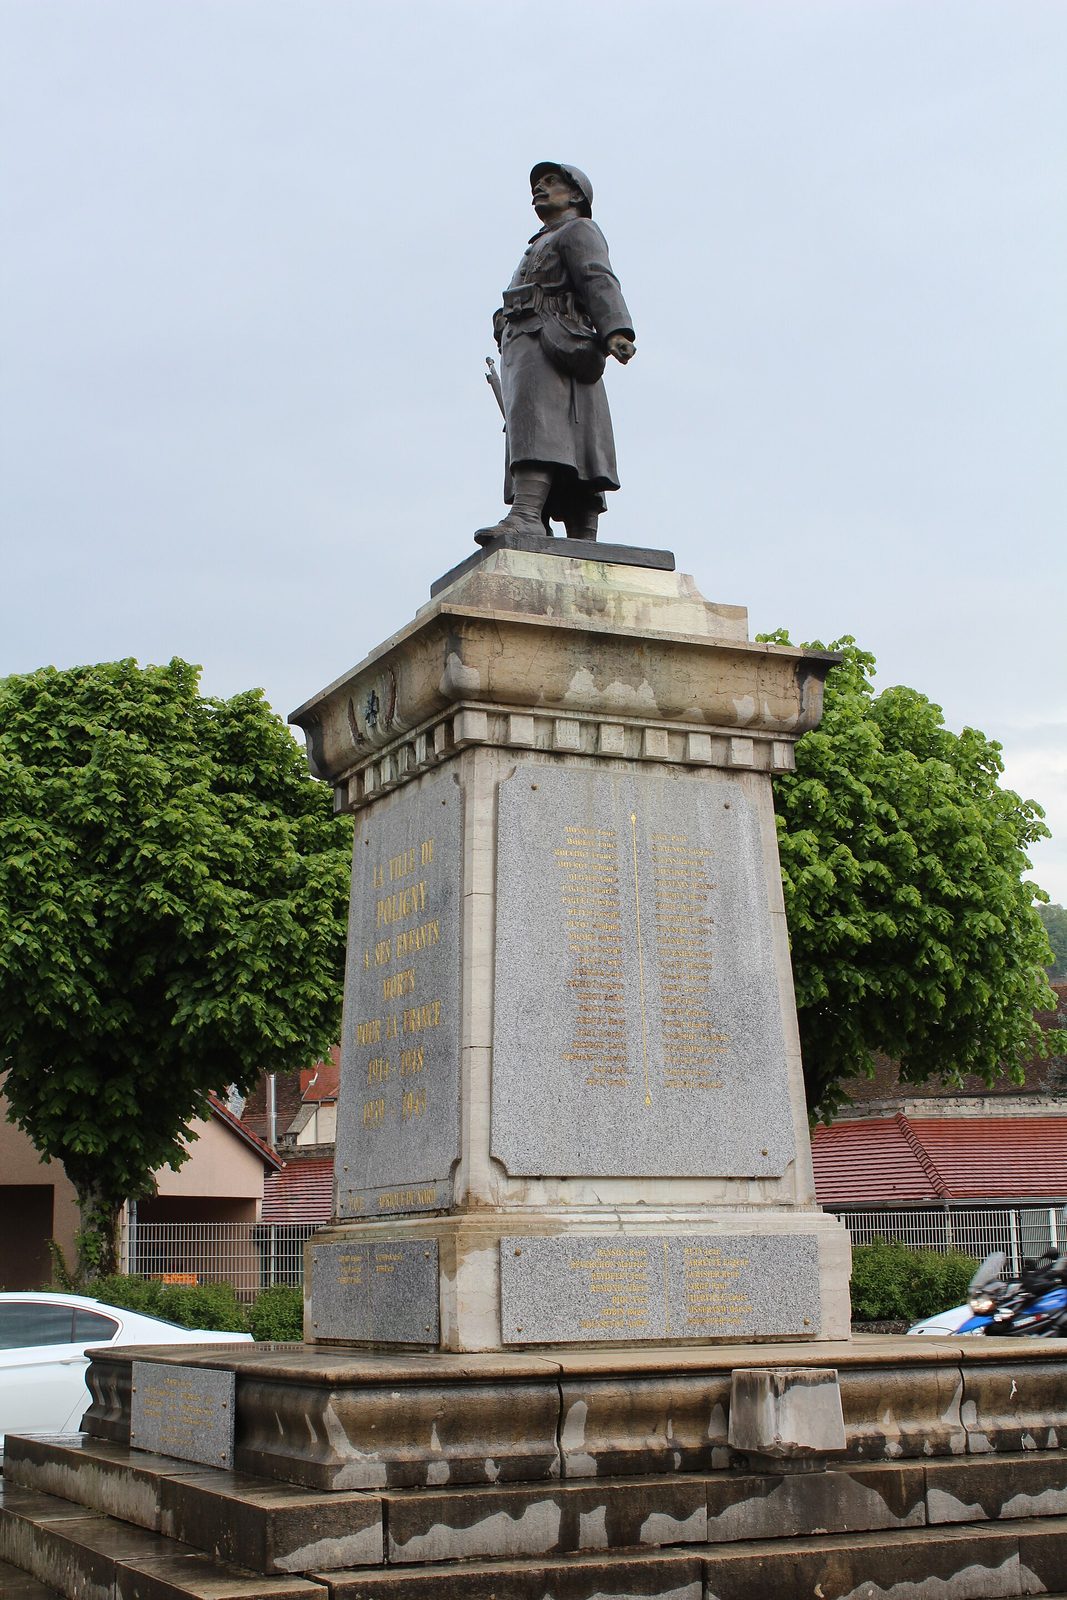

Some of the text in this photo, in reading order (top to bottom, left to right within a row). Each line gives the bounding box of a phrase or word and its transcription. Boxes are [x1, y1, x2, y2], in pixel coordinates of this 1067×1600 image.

[373, 838, 433, 888] LA VILLE DE
[376, 881, 427, 929] POLIGNY
[375, 938, 391, 966] SES
[396, 919, 440, 958] ENFANTS
[382, 968, 416, 1001] MORTS
[356, 1000, 441, 1046] POUR LA FRANCE
[367, 1056, 389, 1086] 1914
[400, 1046, 424, 1078] 1918
[362, 1098, 384, 1126] 1939
[416, 1187, 436, 1206] NORD
